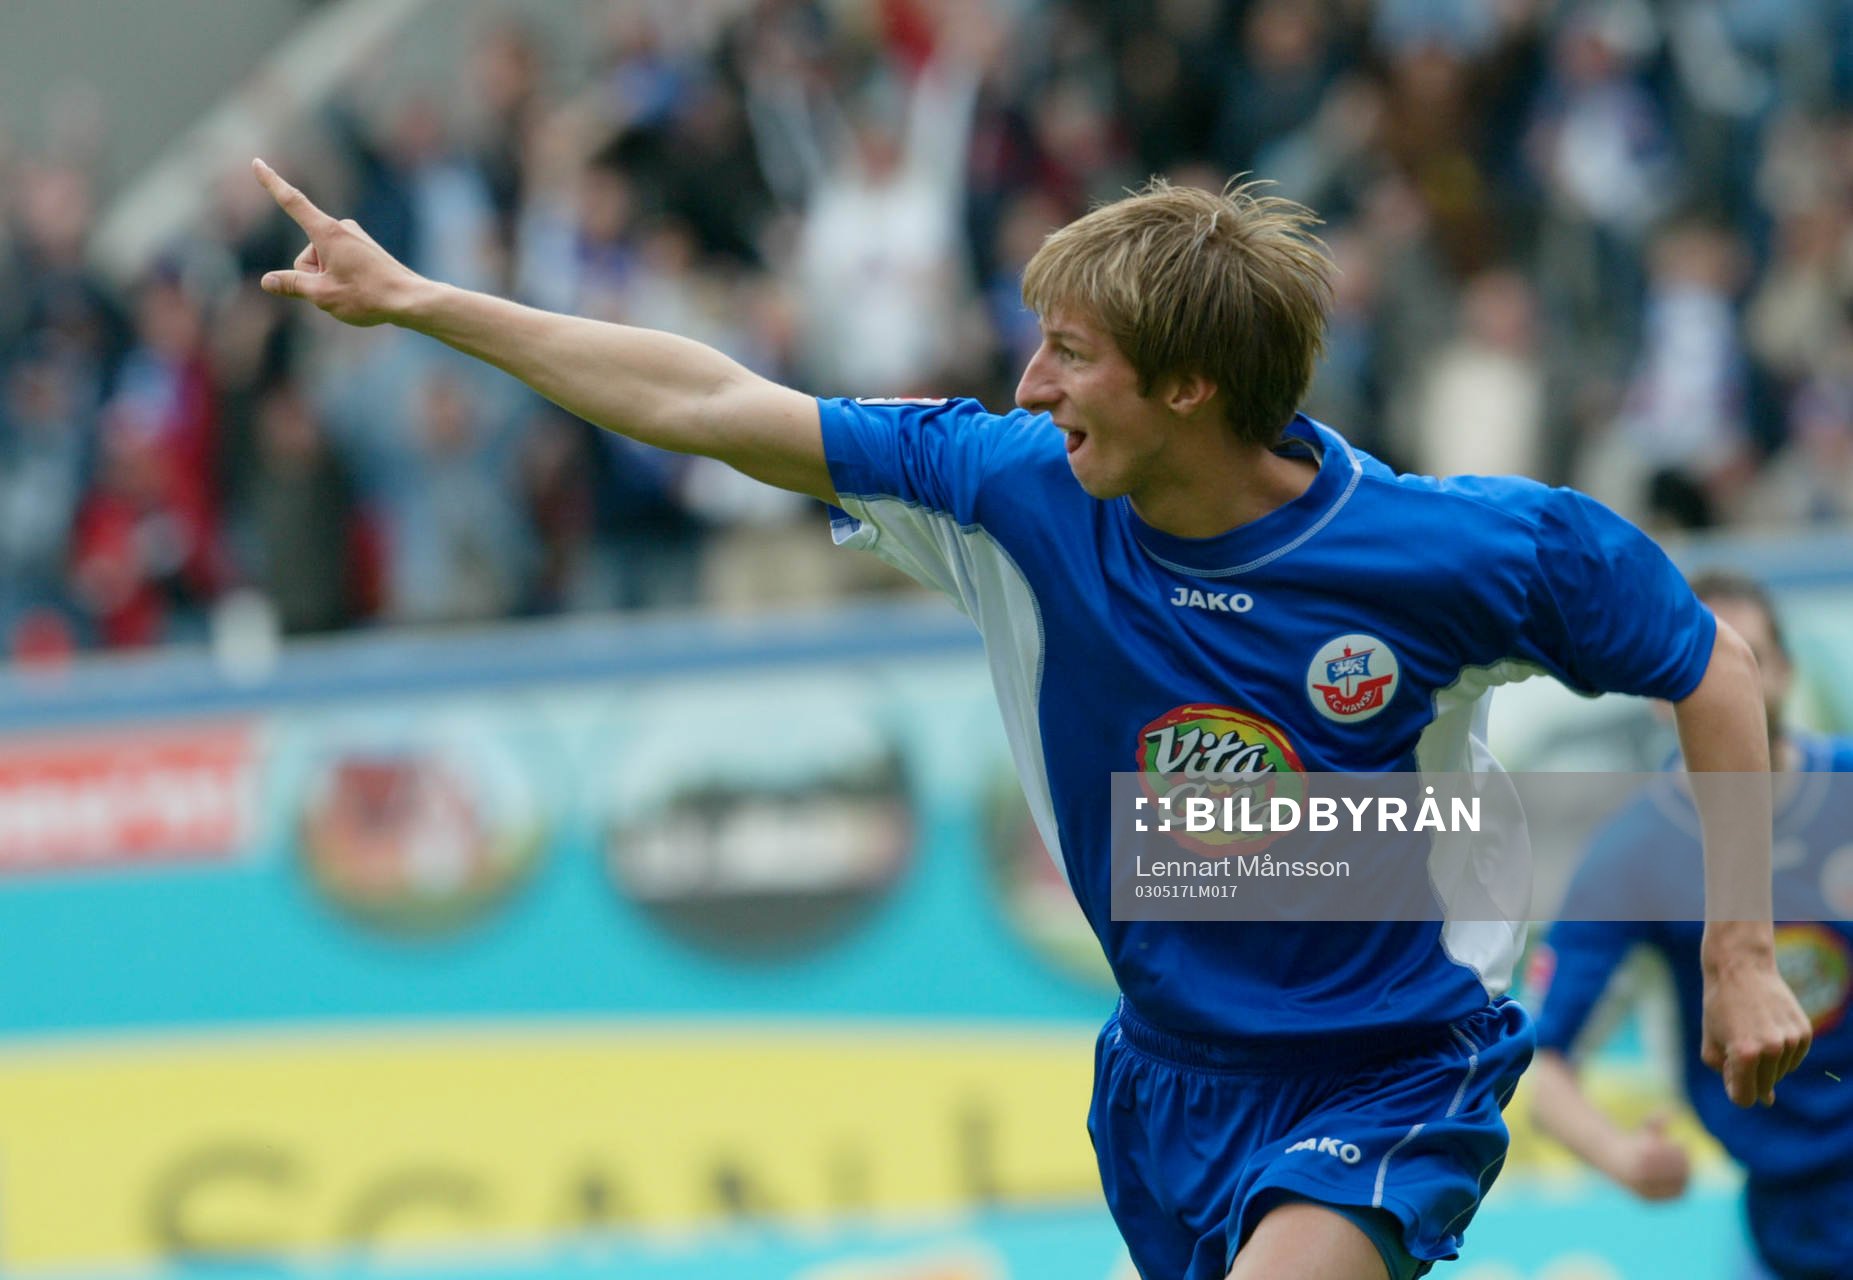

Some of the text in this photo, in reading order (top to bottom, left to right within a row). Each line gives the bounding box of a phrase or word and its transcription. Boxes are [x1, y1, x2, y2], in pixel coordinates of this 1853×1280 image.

[1170, 588, 1254, 613] JAKO
[1342, 690, 1373, 712] HANSA
[1145, 726, 1275, 783] Vita
